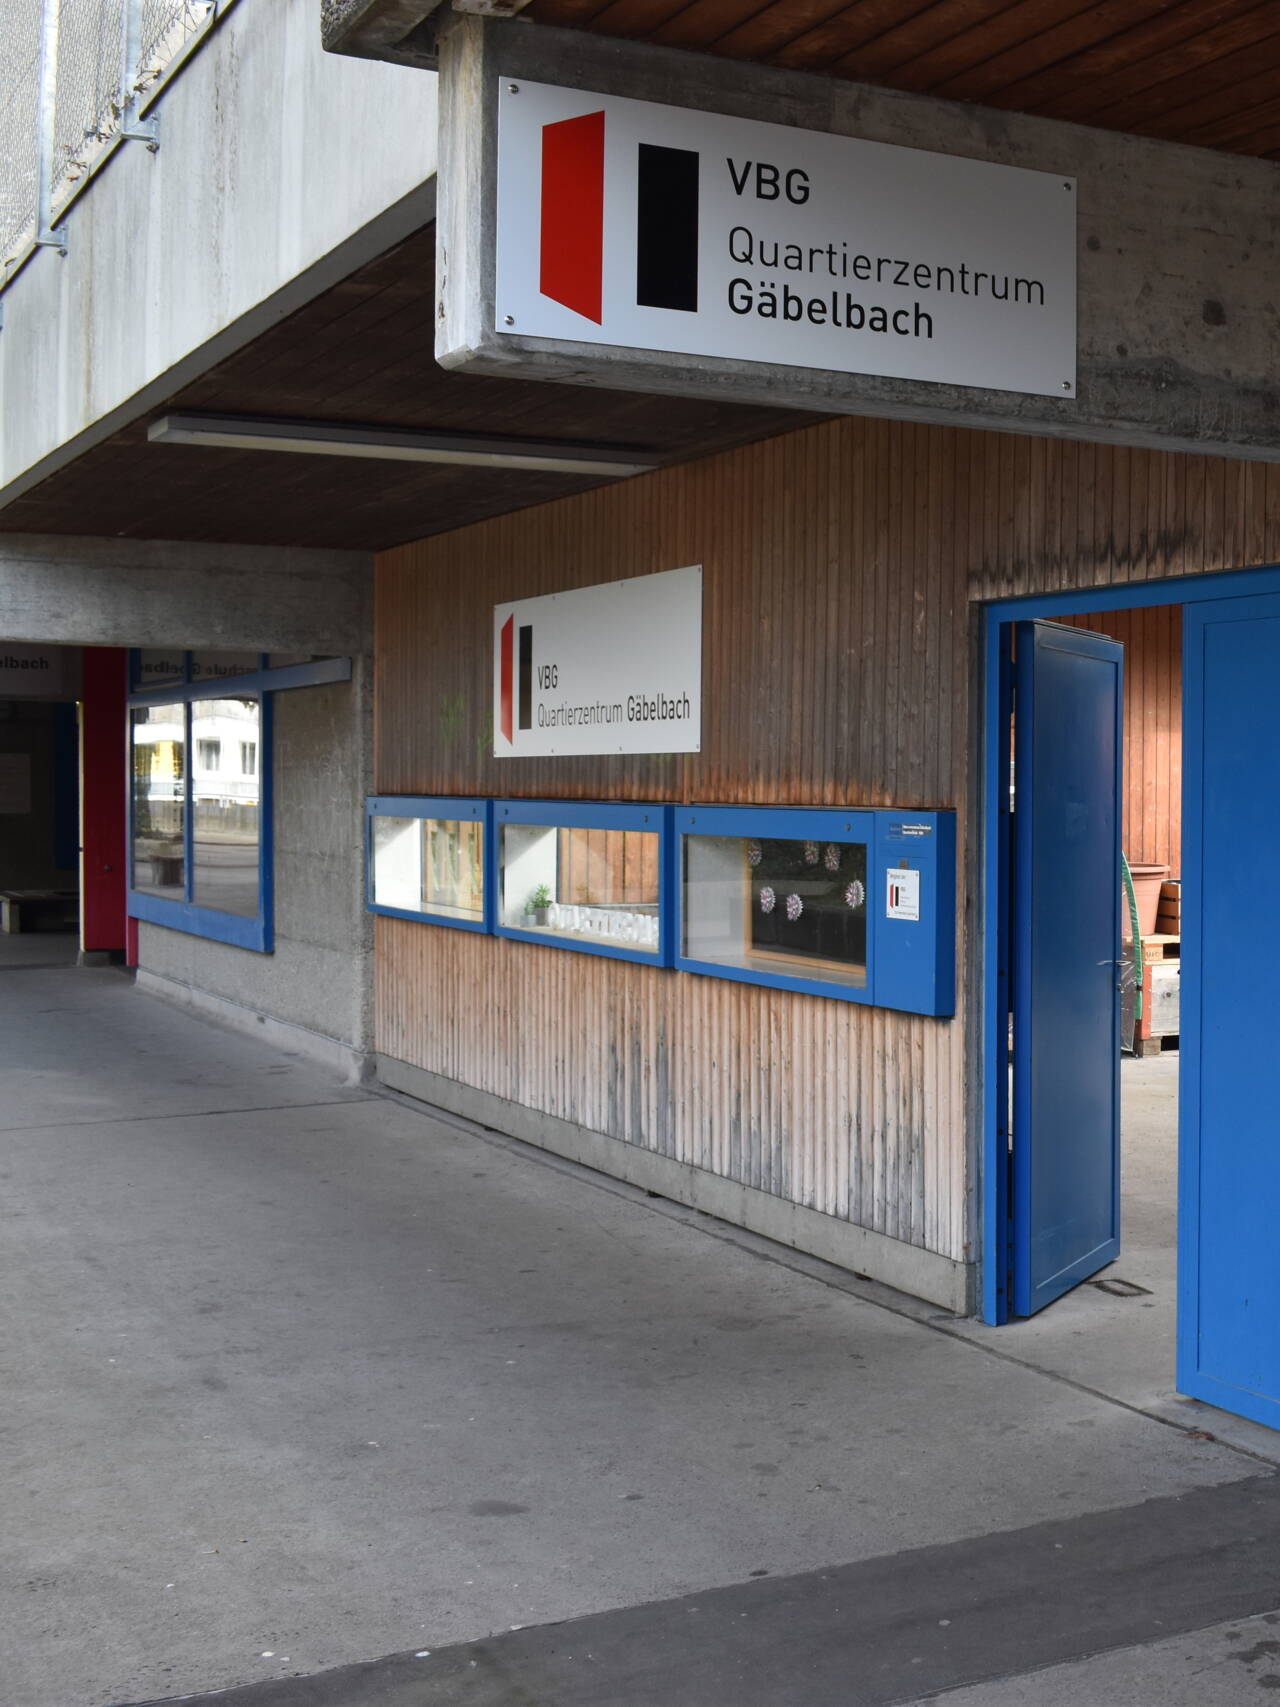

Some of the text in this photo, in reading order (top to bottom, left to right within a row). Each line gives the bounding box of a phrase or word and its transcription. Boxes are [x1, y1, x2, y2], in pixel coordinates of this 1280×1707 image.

[727, 157, 811, 205] VBG
[728, 226, 1045, 306] Quartierzentrum
[727, 278, 934, 339] Gäbelbach
[538, 664, 558, 690] VBG
[538, 692, 690, 727] Quartierzentrum Gäbelbach
